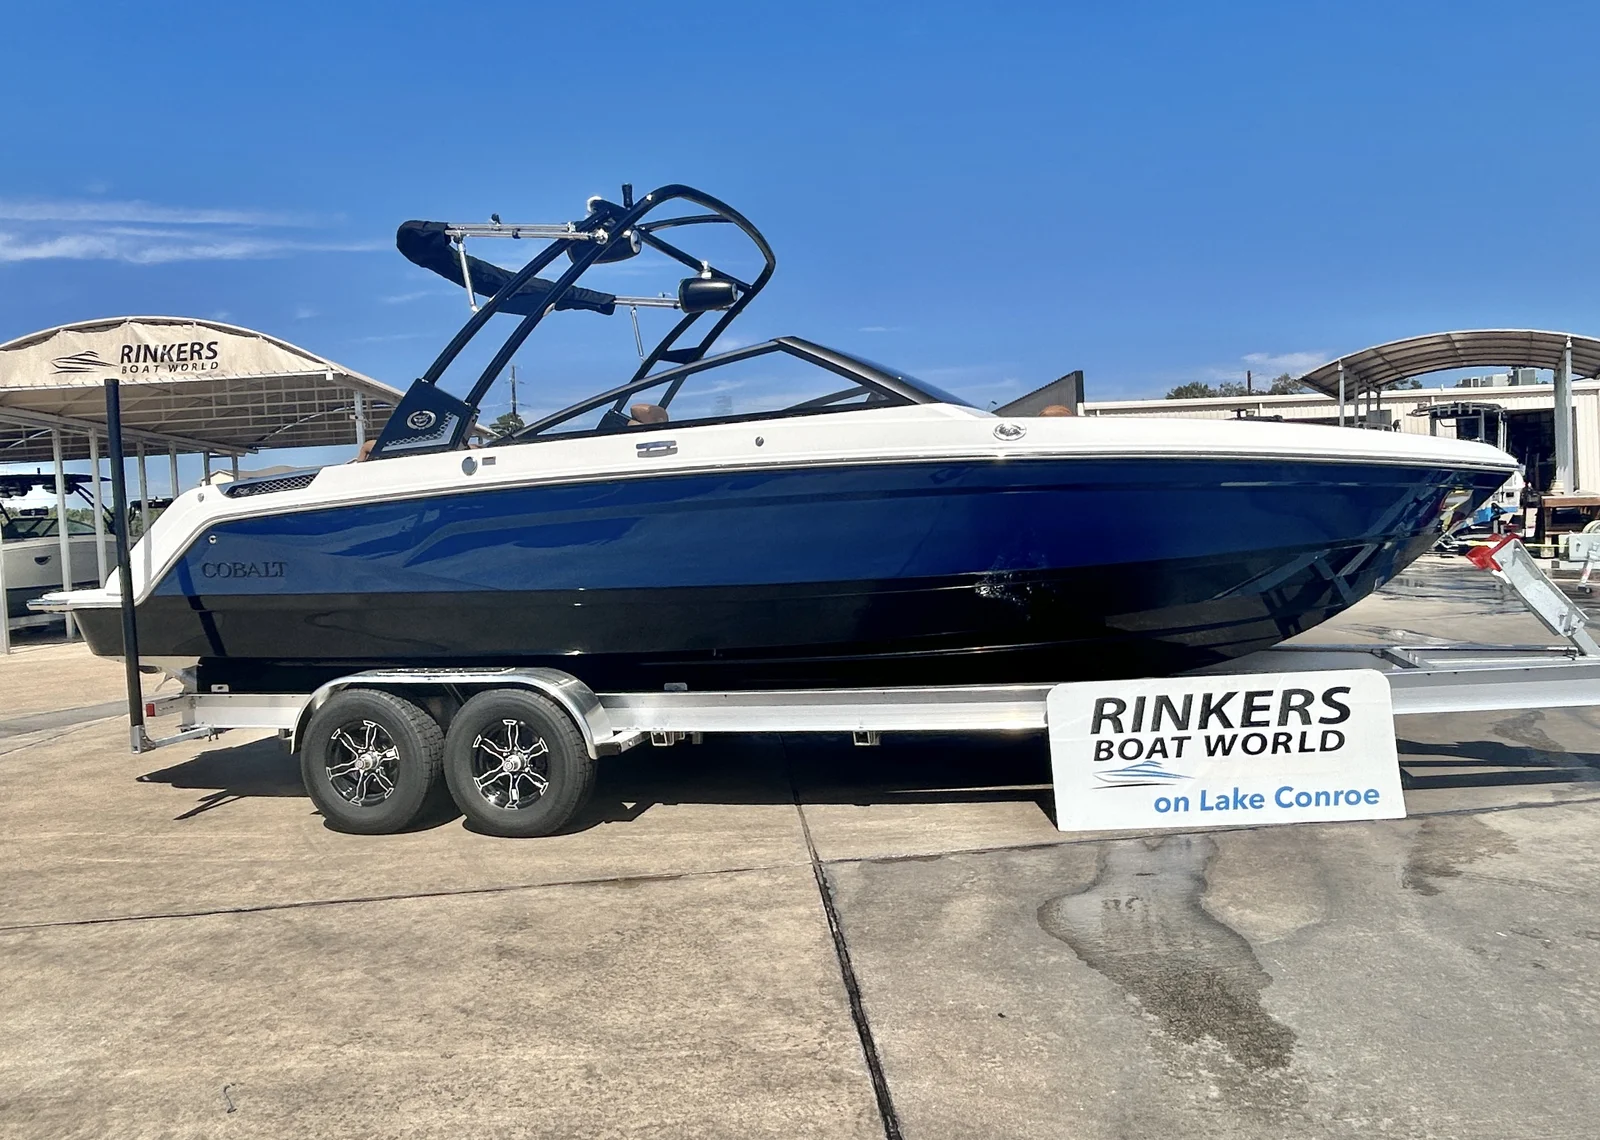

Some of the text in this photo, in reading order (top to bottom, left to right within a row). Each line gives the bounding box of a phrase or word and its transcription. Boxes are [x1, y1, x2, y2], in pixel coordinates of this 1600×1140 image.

[120, 341, 219, 364] RINKERS
[121, 361, 219, 374] BOAT WORLD
[201, 562, 288, 579] COBALT
[1090, 686, 1351, 735] RINKERS
[1093, 730, 1346, 762] BOAT WORLD
[1154, 786, 1380, 813] on Lake Conroe
